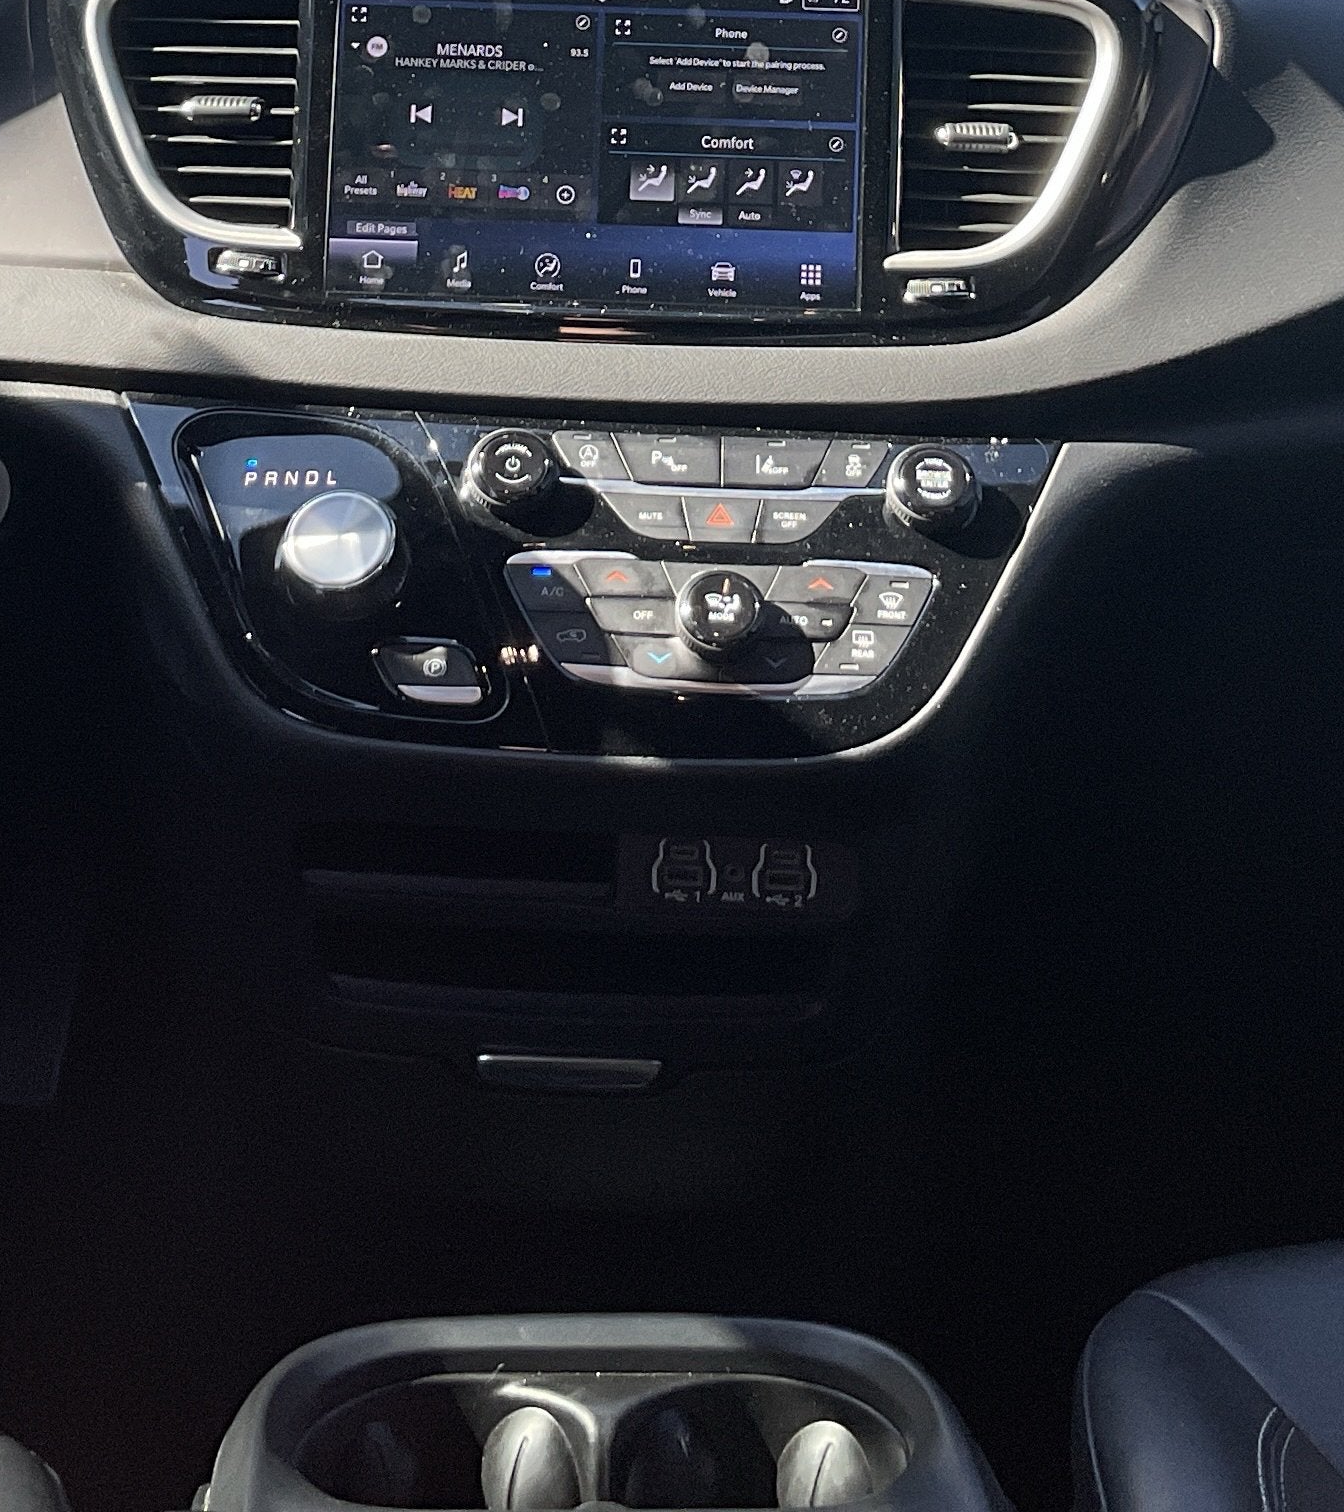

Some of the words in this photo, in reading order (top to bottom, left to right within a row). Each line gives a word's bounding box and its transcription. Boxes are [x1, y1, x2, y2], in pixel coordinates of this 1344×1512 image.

[714, 27, 749, 40] Phone
[436, 43, 504, 58] MENARDS
[569, 47, 590, 58] 93.5
[395, 57, 439, 68] HANKEY
[440, 58, 476, 69] MARKS
[478, 59, 486, 69] &
[487, 60, 526, 71] CRIDER
[649, 56, 674, 66] Select
[723, 59, 731, 67] to
[732, 59, 750, 68] start
[765, 60, 792, 71] pairing
[669, 81, 686, 91] Add
[687, 82, 713, 92] Device
[736, 84, 762, 94] Device
[763, 85, 799, 96] Manager
[701, 135, 754, 150] Comfort
[355, 175, 368, 184] All
[440, 171, 446, 181] 2
[491, 174, 497, 183] 3
[542, 175, 549, 184] 4
[344, 185, 378, 196] Presets
[448, 184, 477, 199] HEAT
[689, 208, 712, 220] Sync
[738, 210, 761, 221] Auto
[355, 223, 375, 234] Edit
[377, 223, 408, 235] Pages
[359, 275, 384, 285] Home
[446, 278, 472, 288] Media
[530, 281, 564, 292] Comfort
[621, 284, 648, 295] Phone
[707, 288, 737, 298] Vehicle
[800, 292, 821, 302] Apps
[580, 460, 596, 468] OFF
[670, 464, 688, 472] OFF
[638, 512, 663, 520] MUTE
[772, 511, 807, 521] SCREEN
[781, 520, 798, 529] OFF
[540, 585, 564, 597] A/C
[632, 610, 654, 620] OFF
[707, 611, 735, 622] MODE
[779, 614, 809, 626] AUTO
[876, 609, 906, 620] FRONT
[851, 648, 875, 658] REAR
[721, 891, 745, 902] AUX
